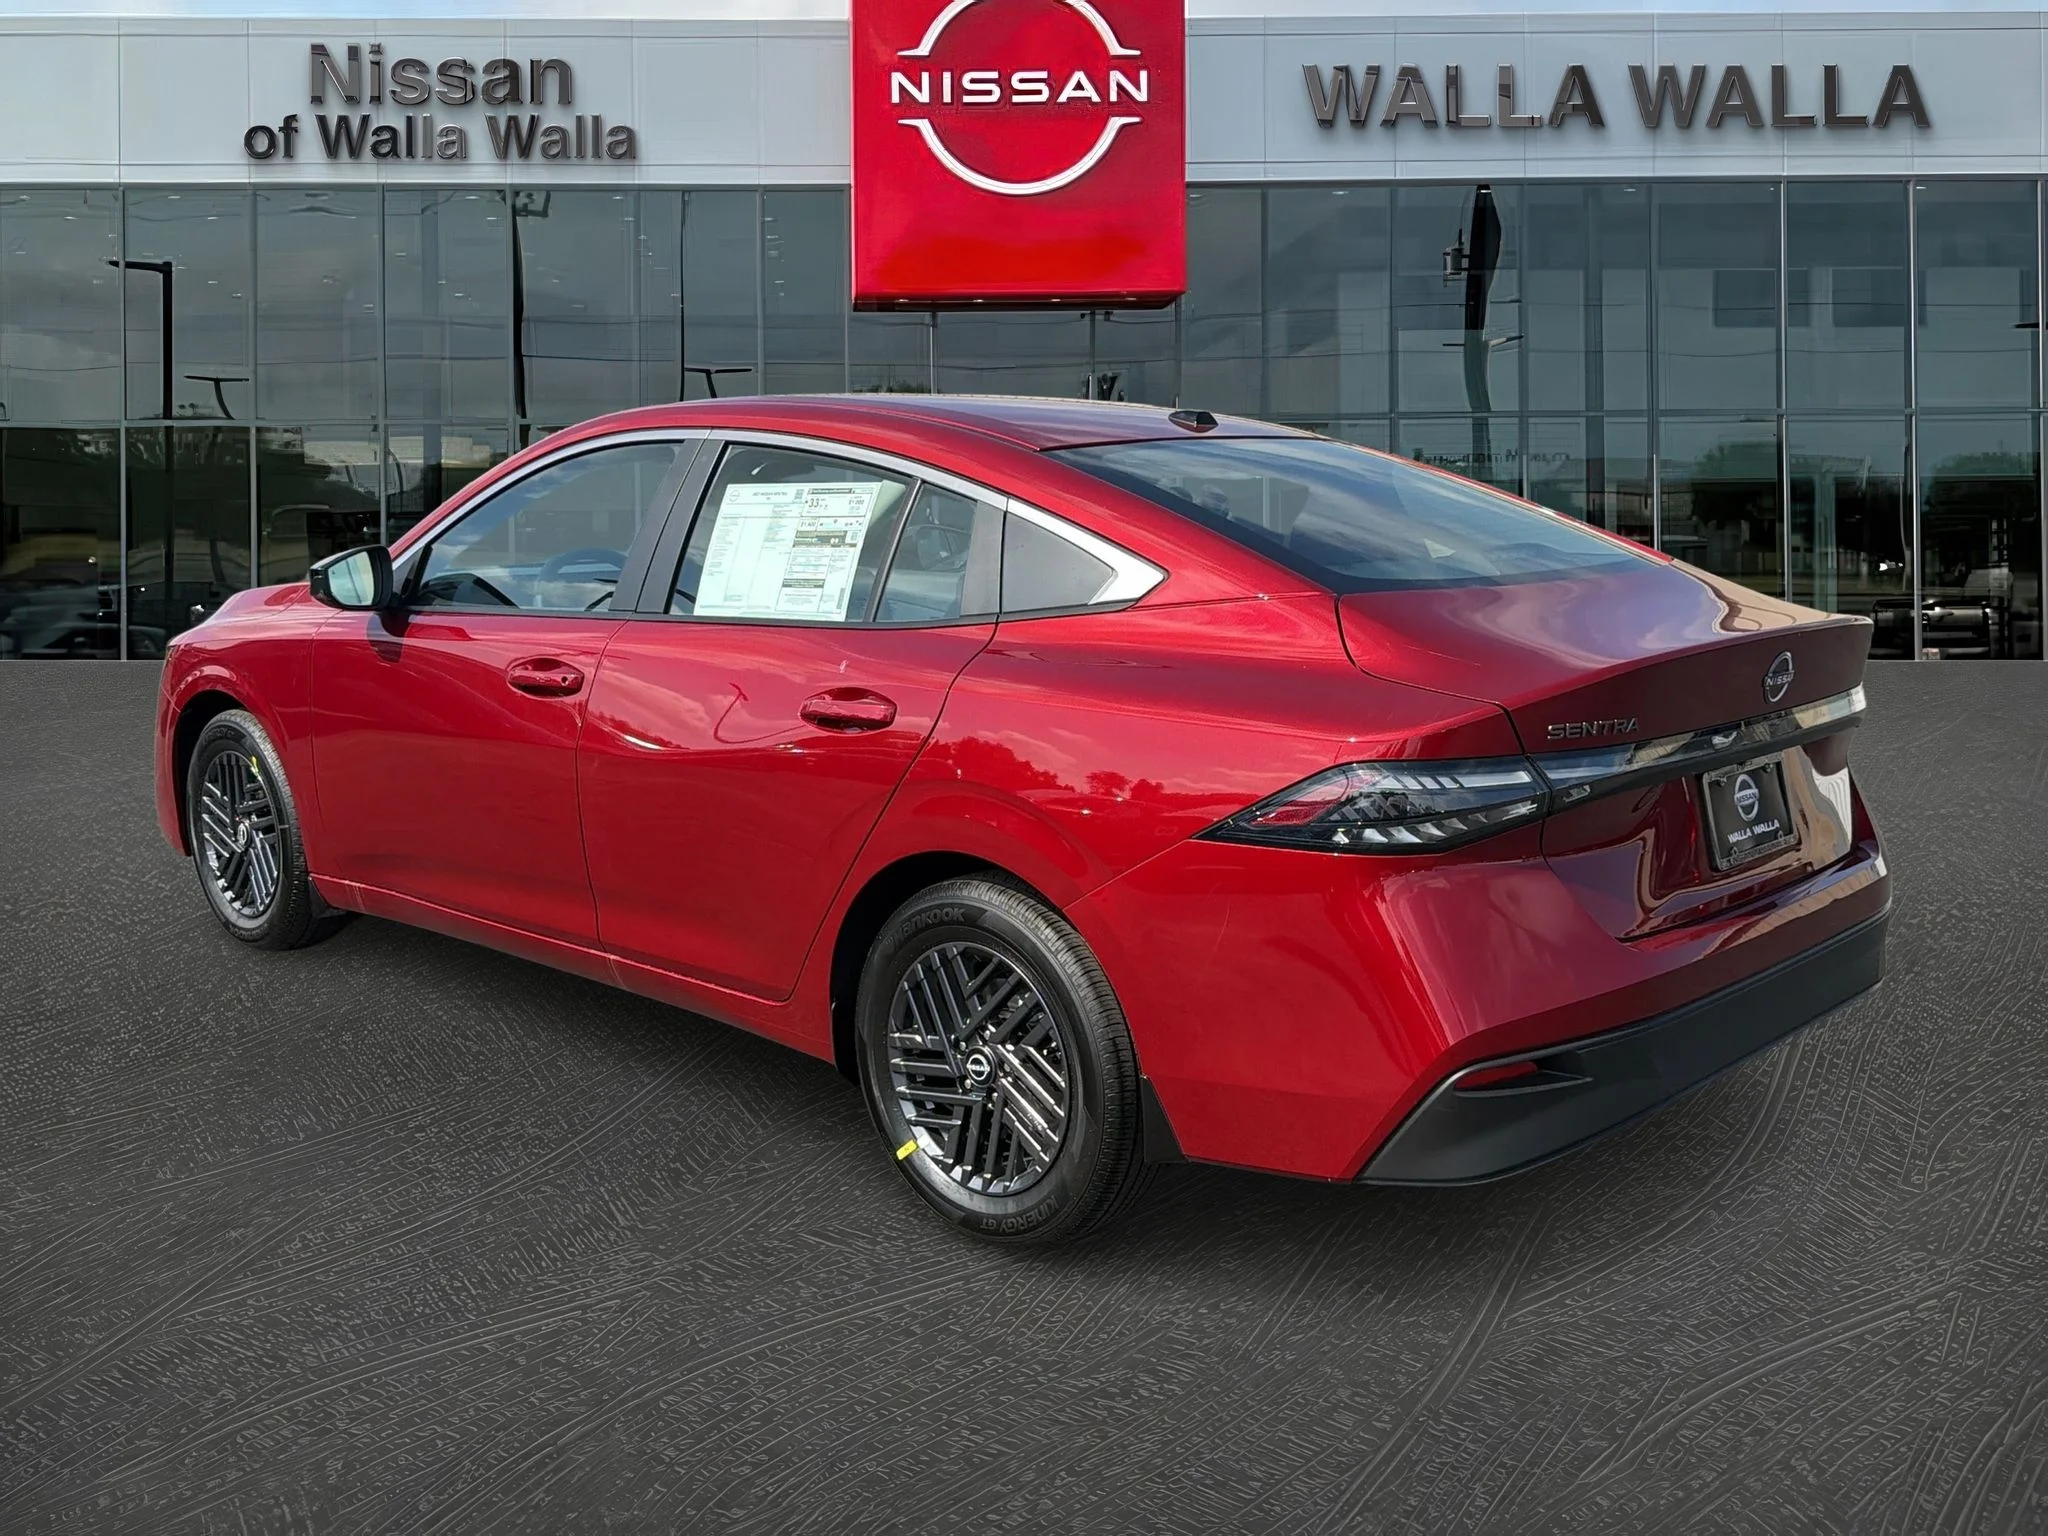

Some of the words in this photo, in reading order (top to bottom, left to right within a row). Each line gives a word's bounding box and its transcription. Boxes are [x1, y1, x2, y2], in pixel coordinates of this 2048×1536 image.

[310, 42, 573, 105] Nissan
[891, 70, 1148, 104] NISSAN
[1302, 63, 1605, 128] WALLA
[1627, 63, 1931, 128] WALLA
[243, 113, 299, 159] of
[314, 113, 469, 160] Walla
[484, 113, 637, 160] Walla
[1547, 718, 1640, 739] SENTRA
[1727, 828, 1752, 844] WALLA
[1752, 819, 1780, 835] WALLA
